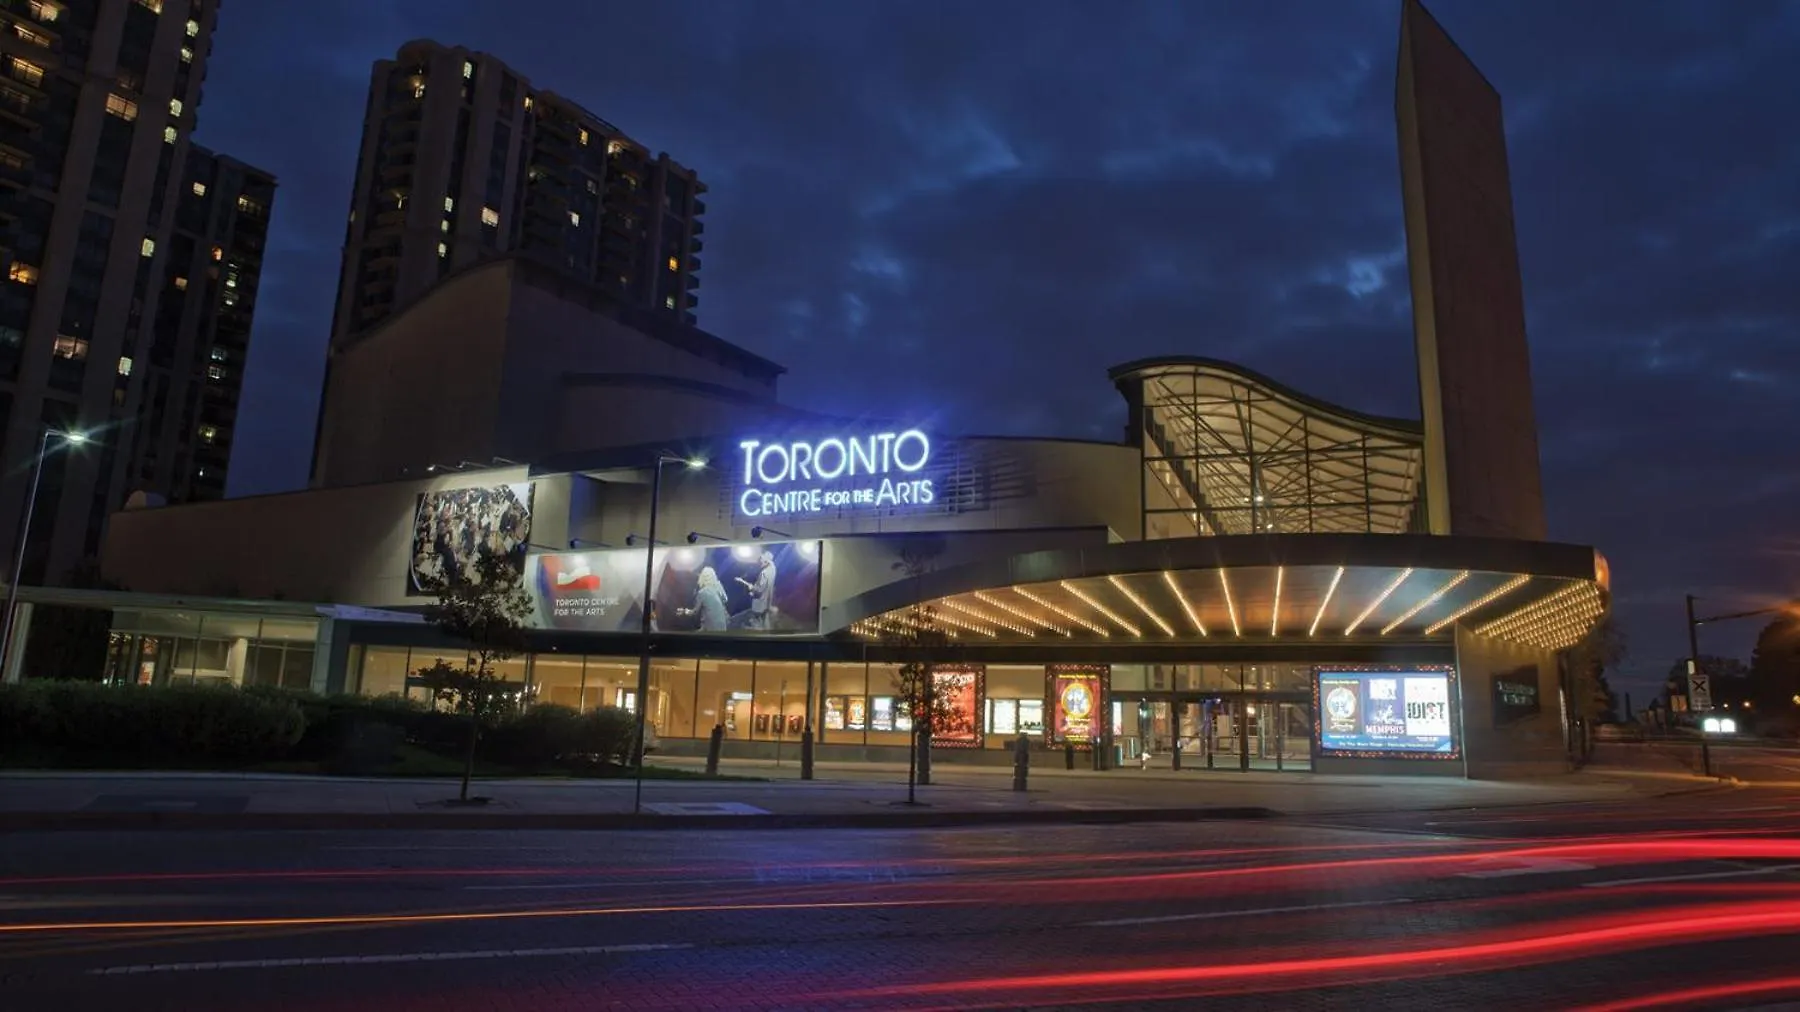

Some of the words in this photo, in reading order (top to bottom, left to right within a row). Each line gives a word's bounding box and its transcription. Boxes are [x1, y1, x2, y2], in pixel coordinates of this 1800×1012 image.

[740, 430, 929, 485] TORONTO
[741, 489, 821, 516] CENTRE
[825, 491, 850, 505] FOR
[853, 488, 874, 503] THE
[876, 478, 933, 506] ARTS
[554, 608, 569, 616] FOR
[571, 608, 584, 616] THE
[586, 608, 605, 616] ARTS
[556, 598, 590, 607] TORONTO
